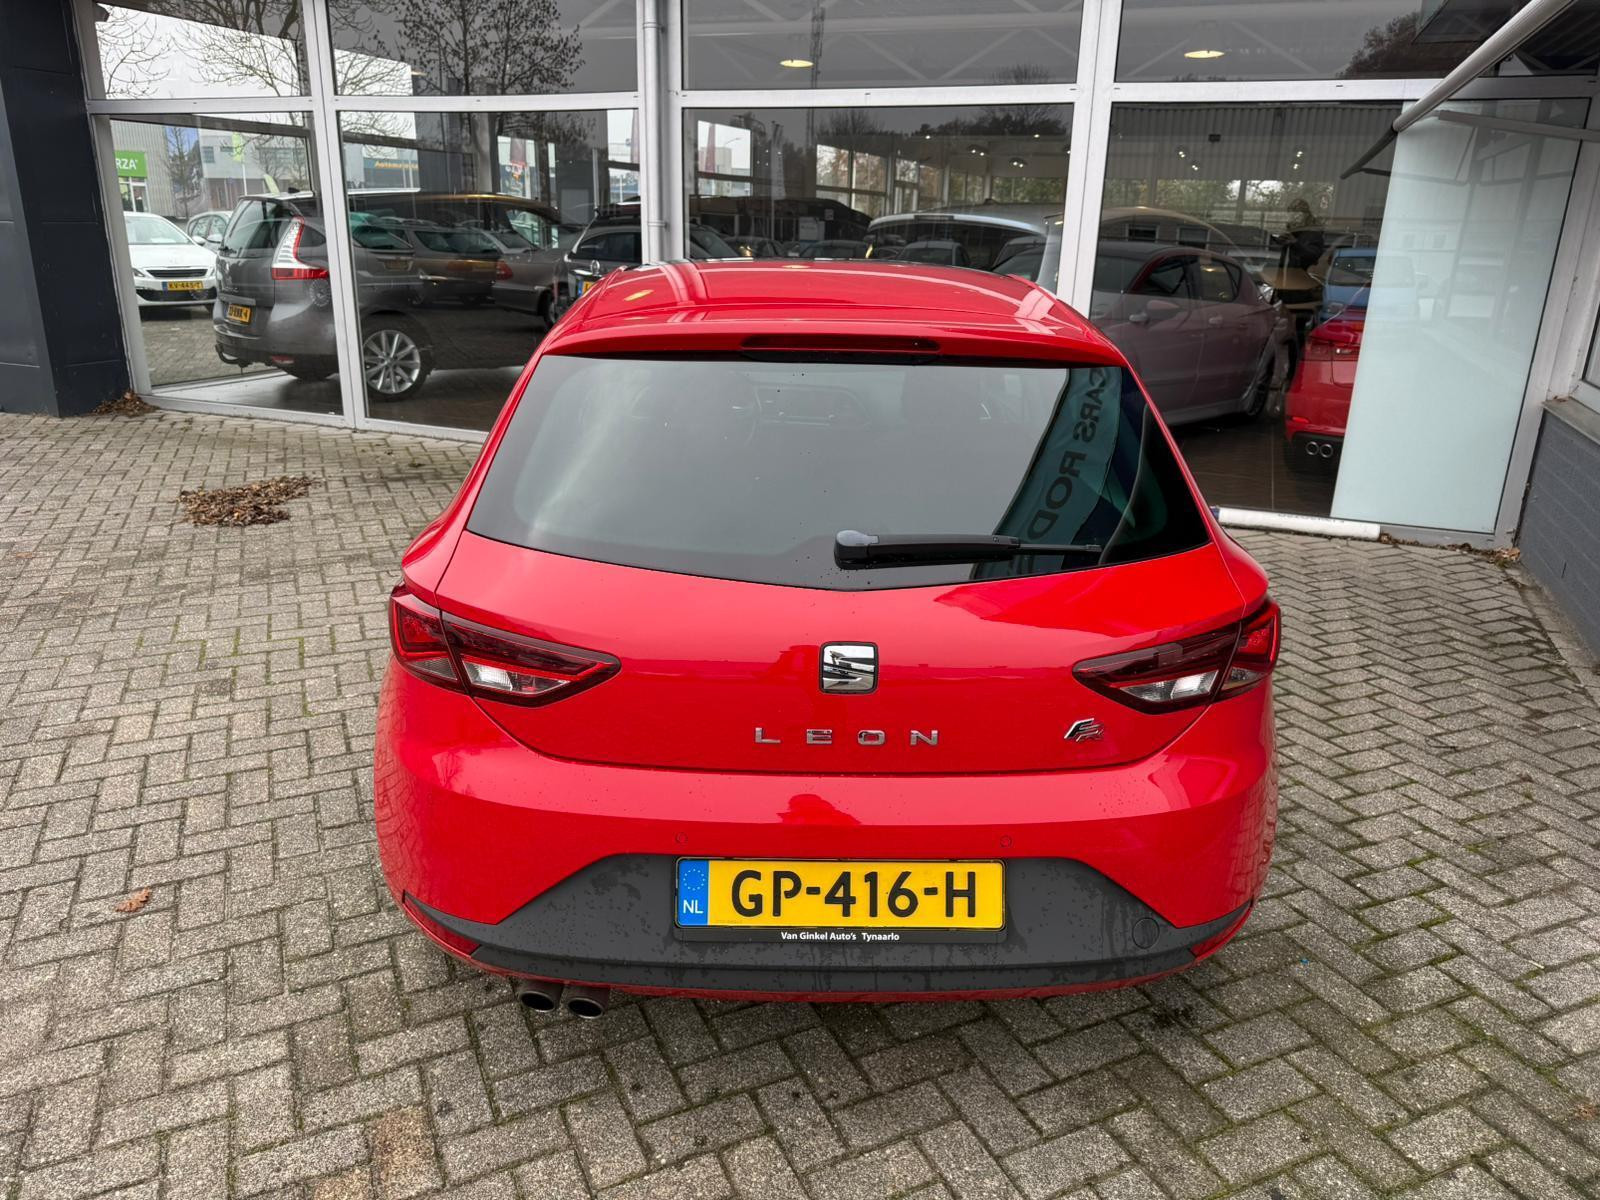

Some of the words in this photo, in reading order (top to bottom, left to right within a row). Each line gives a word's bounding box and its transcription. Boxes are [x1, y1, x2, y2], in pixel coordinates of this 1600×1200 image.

[755, 727, 939, 746] LEON
[731, 869, 976, 918] GP-416-H
[682, 900, 703, 914] NL
[780, 931, 799, 941] Van
[799, 931, 828, 942] Ginkel
[829, 931, 857, 941] Auto's
[861, 931, 900, 943] Tynaarlo
